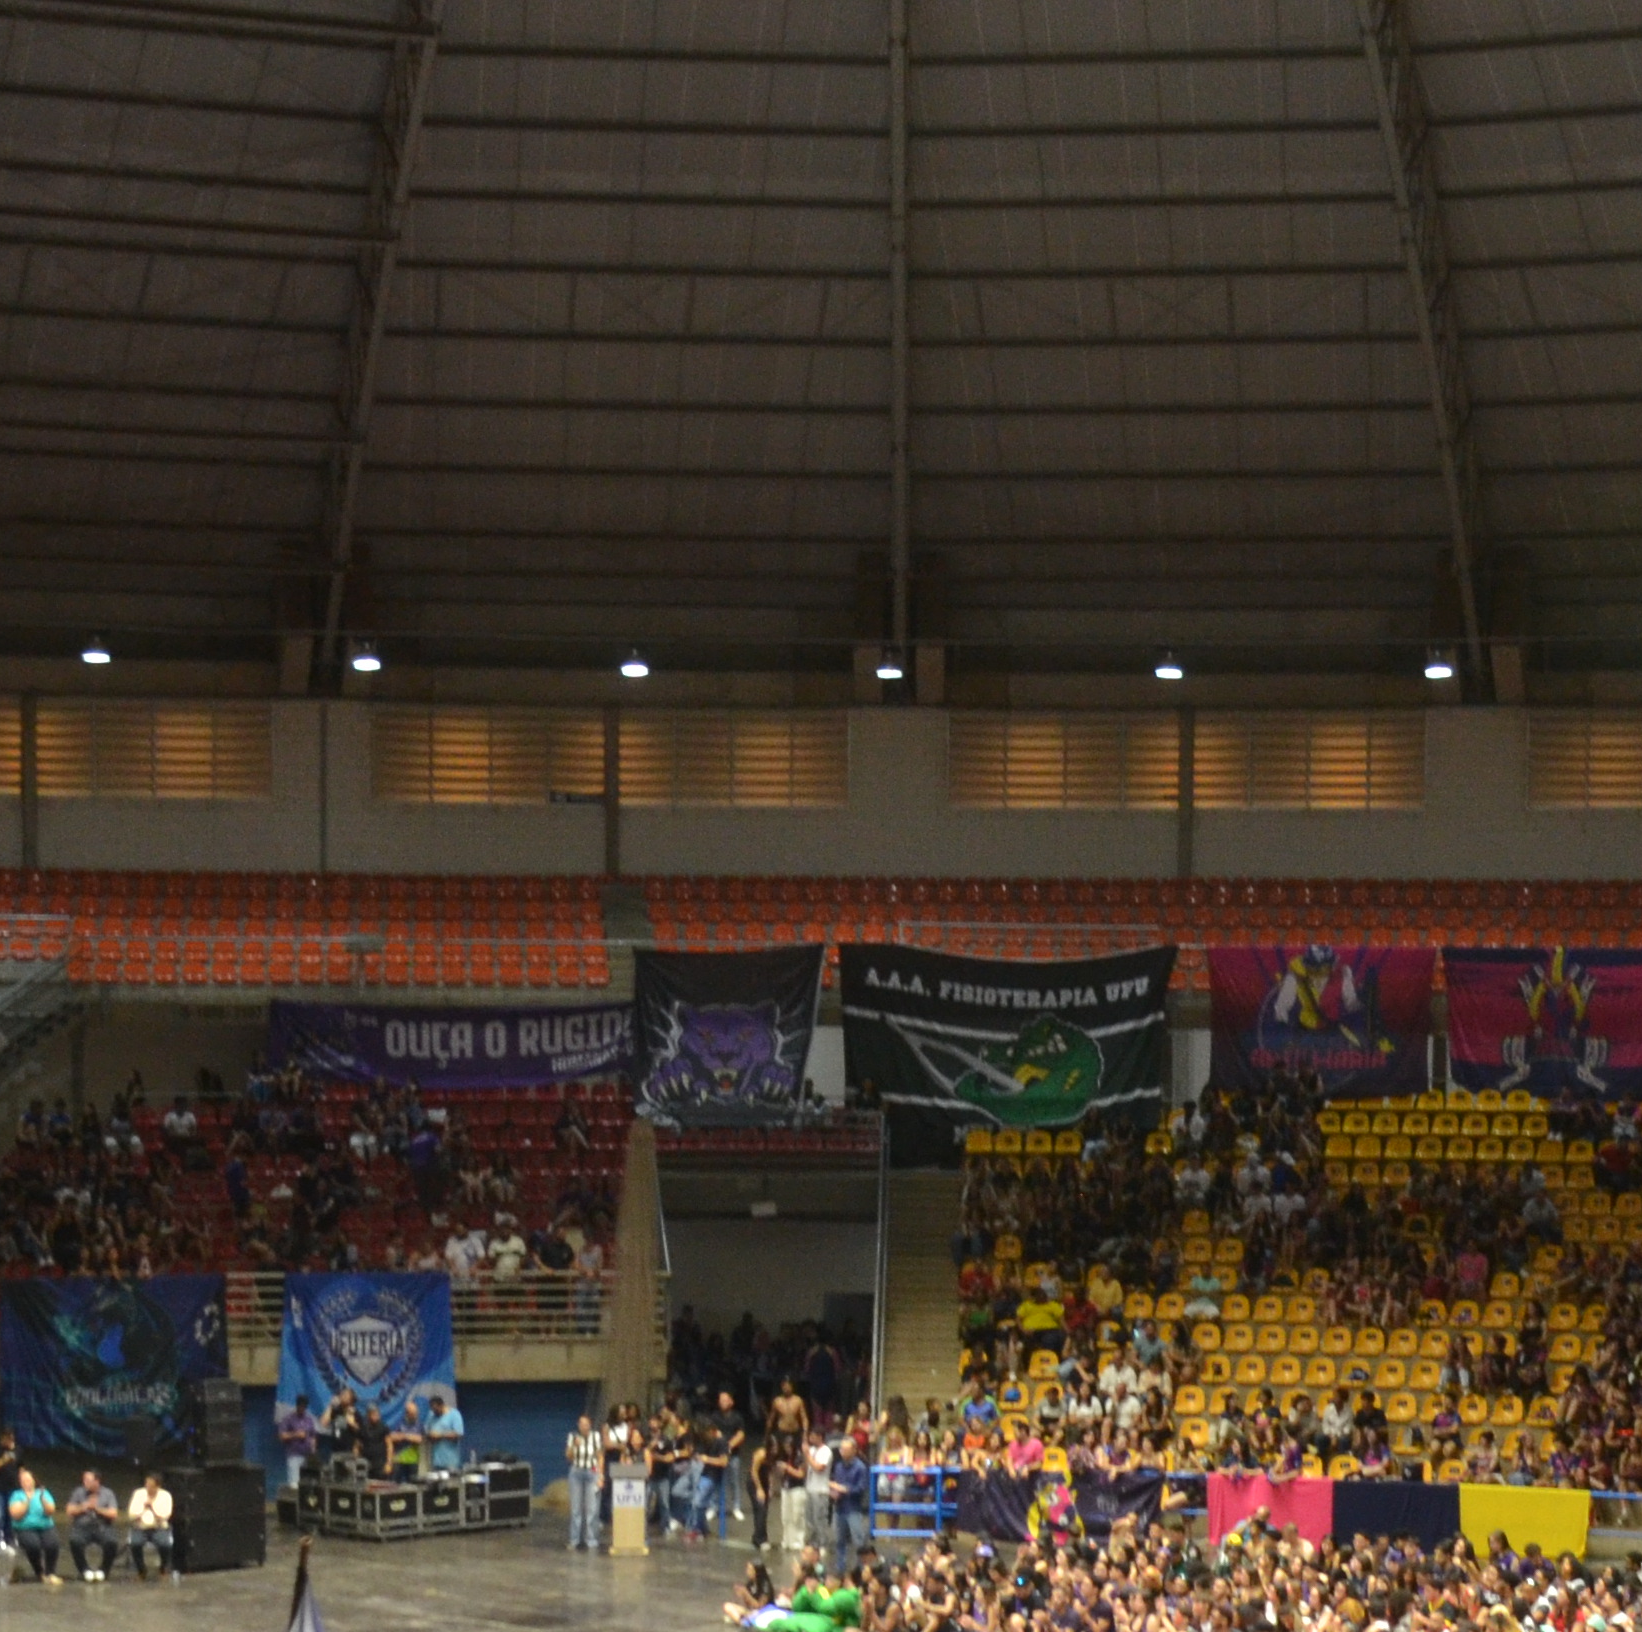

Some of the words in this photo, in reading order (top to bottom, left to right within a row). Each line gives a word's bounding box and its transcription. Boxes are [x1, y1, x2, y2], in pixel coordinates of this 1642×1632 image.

[938, 979, 1098, 1009] FISIOTERAPIA
[1105, 976, 1150, 1002] UFU
[385, 1019, 474, 1069] OUÇA
[484, 1019, 508, 1059] O
